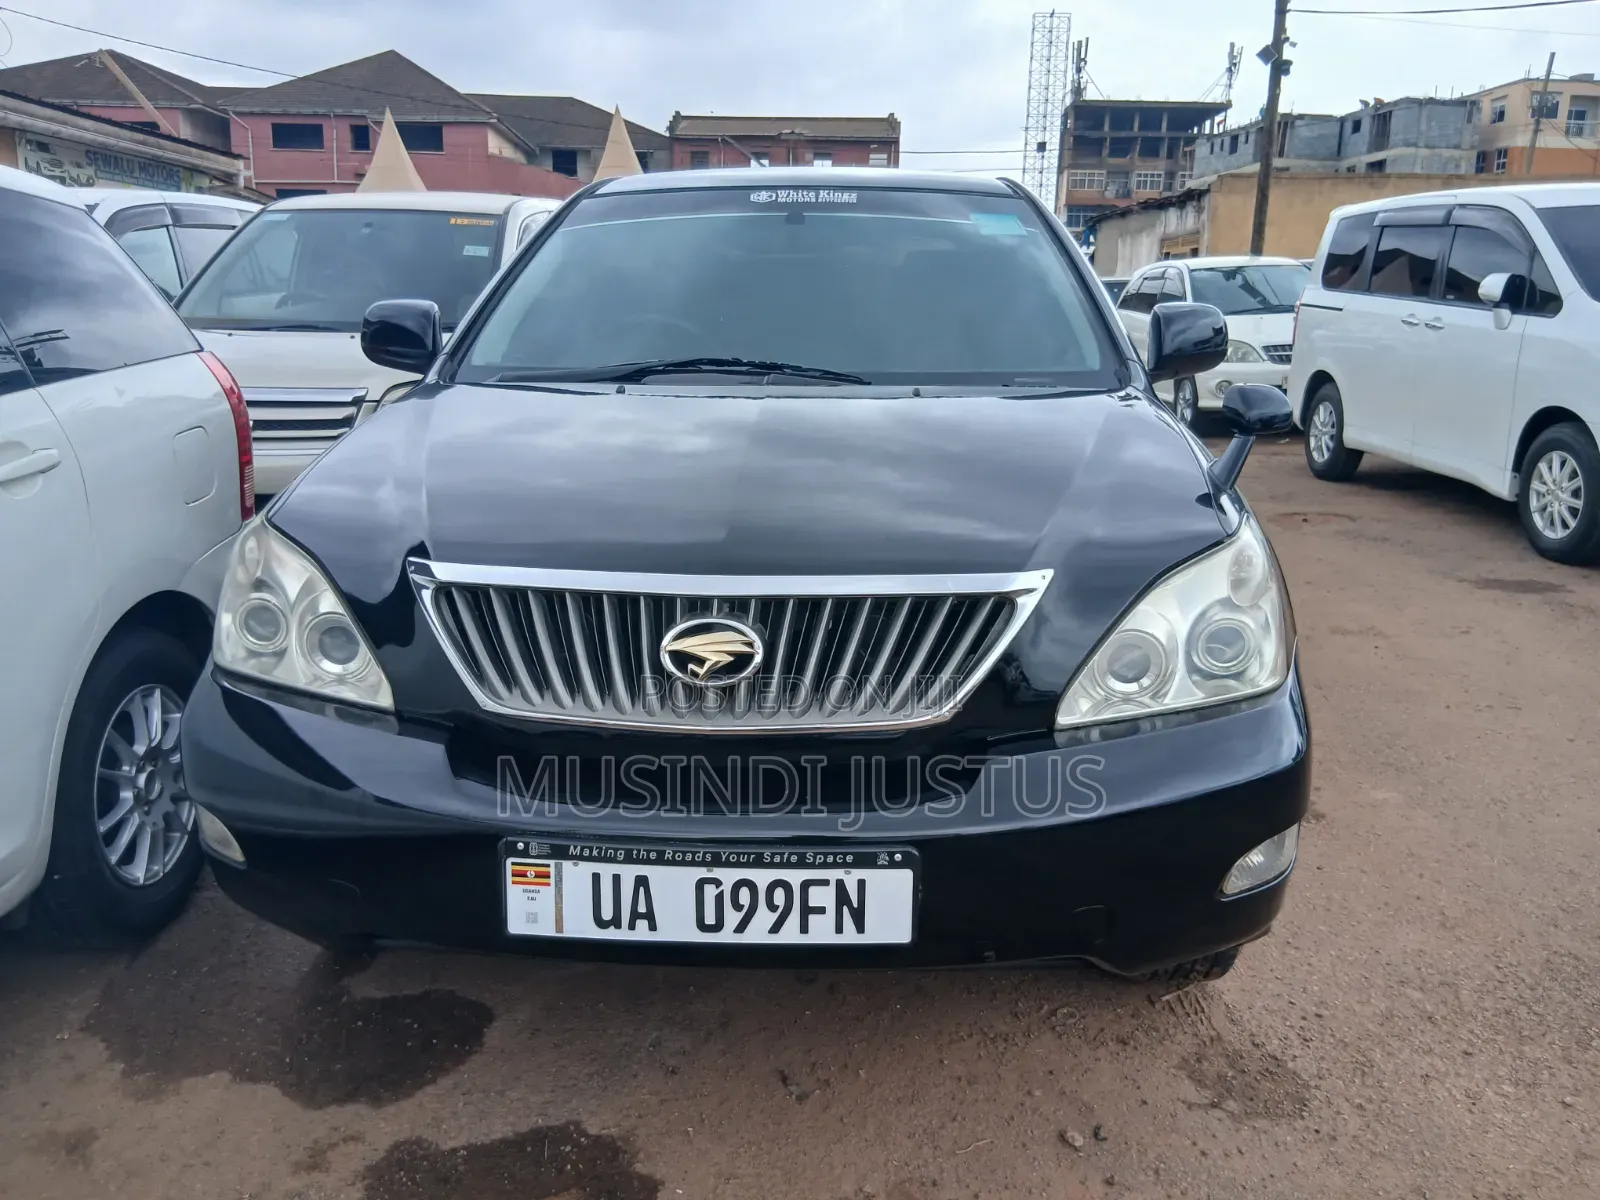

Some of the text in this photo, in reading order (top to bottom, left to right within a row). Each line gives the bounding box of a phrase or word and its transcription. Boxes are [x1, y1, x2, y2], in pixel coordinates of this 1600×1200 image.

[85, 150, 134, 173] SEWALU
[139, 159, 182, 183] MOTORS
[777, 190, 858, 199] White Kingz
[569, 845, 854, 865] Making the Roads Your Safe Space
[591, 872, 867, 935] UA 099FN
